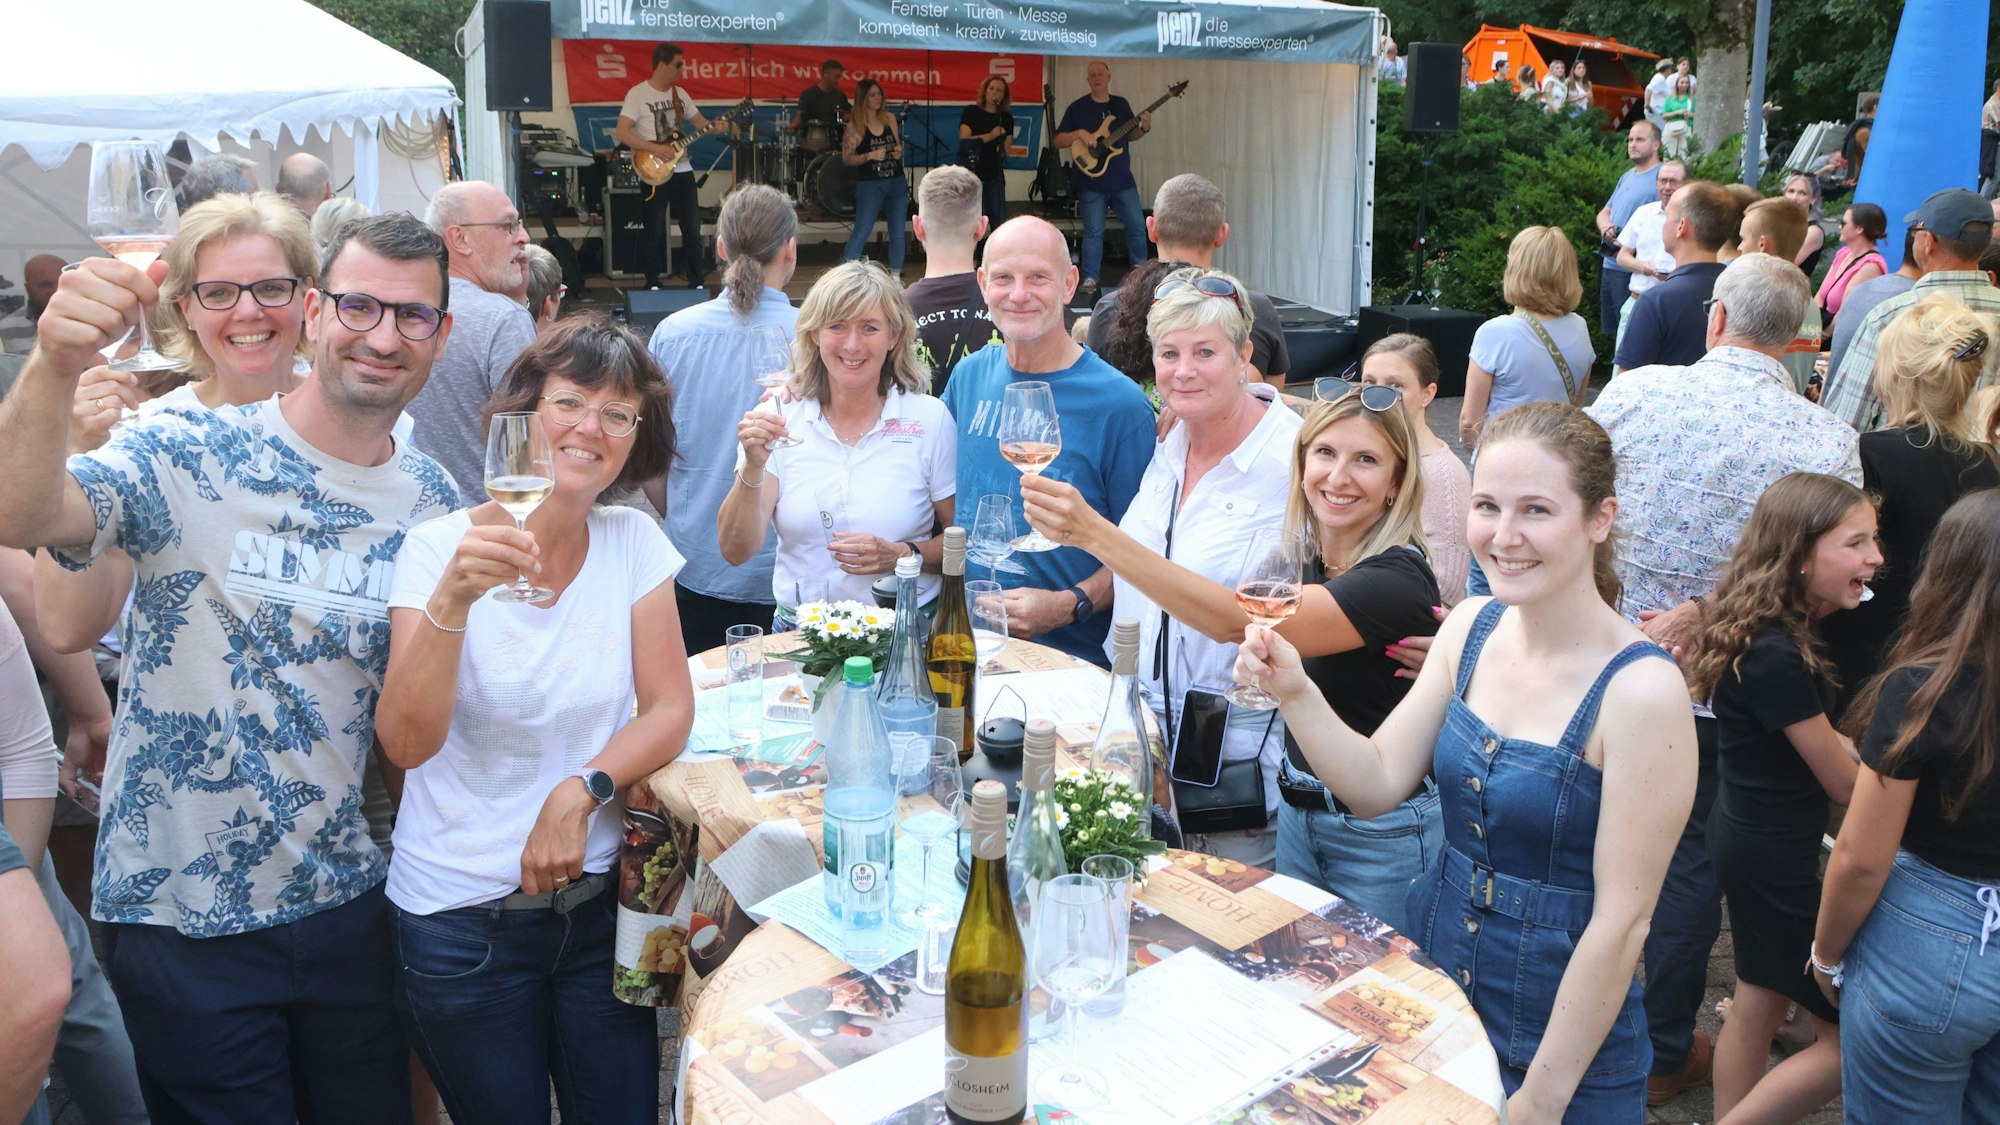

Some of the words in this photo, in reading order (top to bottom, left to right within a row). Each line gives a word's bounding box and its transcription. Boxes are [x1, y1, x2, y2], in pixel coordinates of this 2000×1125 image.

[891, 0, 949, 17] Fenster
[963, 3, 1005, 20] Türen
[1018, 7, 1068, 23] Messe
[859, 18, 940, 38] kompetent
[955, 23, 1006, 40] kreativ
[1019, 28, 1097, 47] zuverlässig
[1157, 11, 1202, 52] penz
[1205, 17, 1229, 32] die
[681, 57, 785, 80] Herzlich
[216, 827, 249, 845] HOLIDAY
